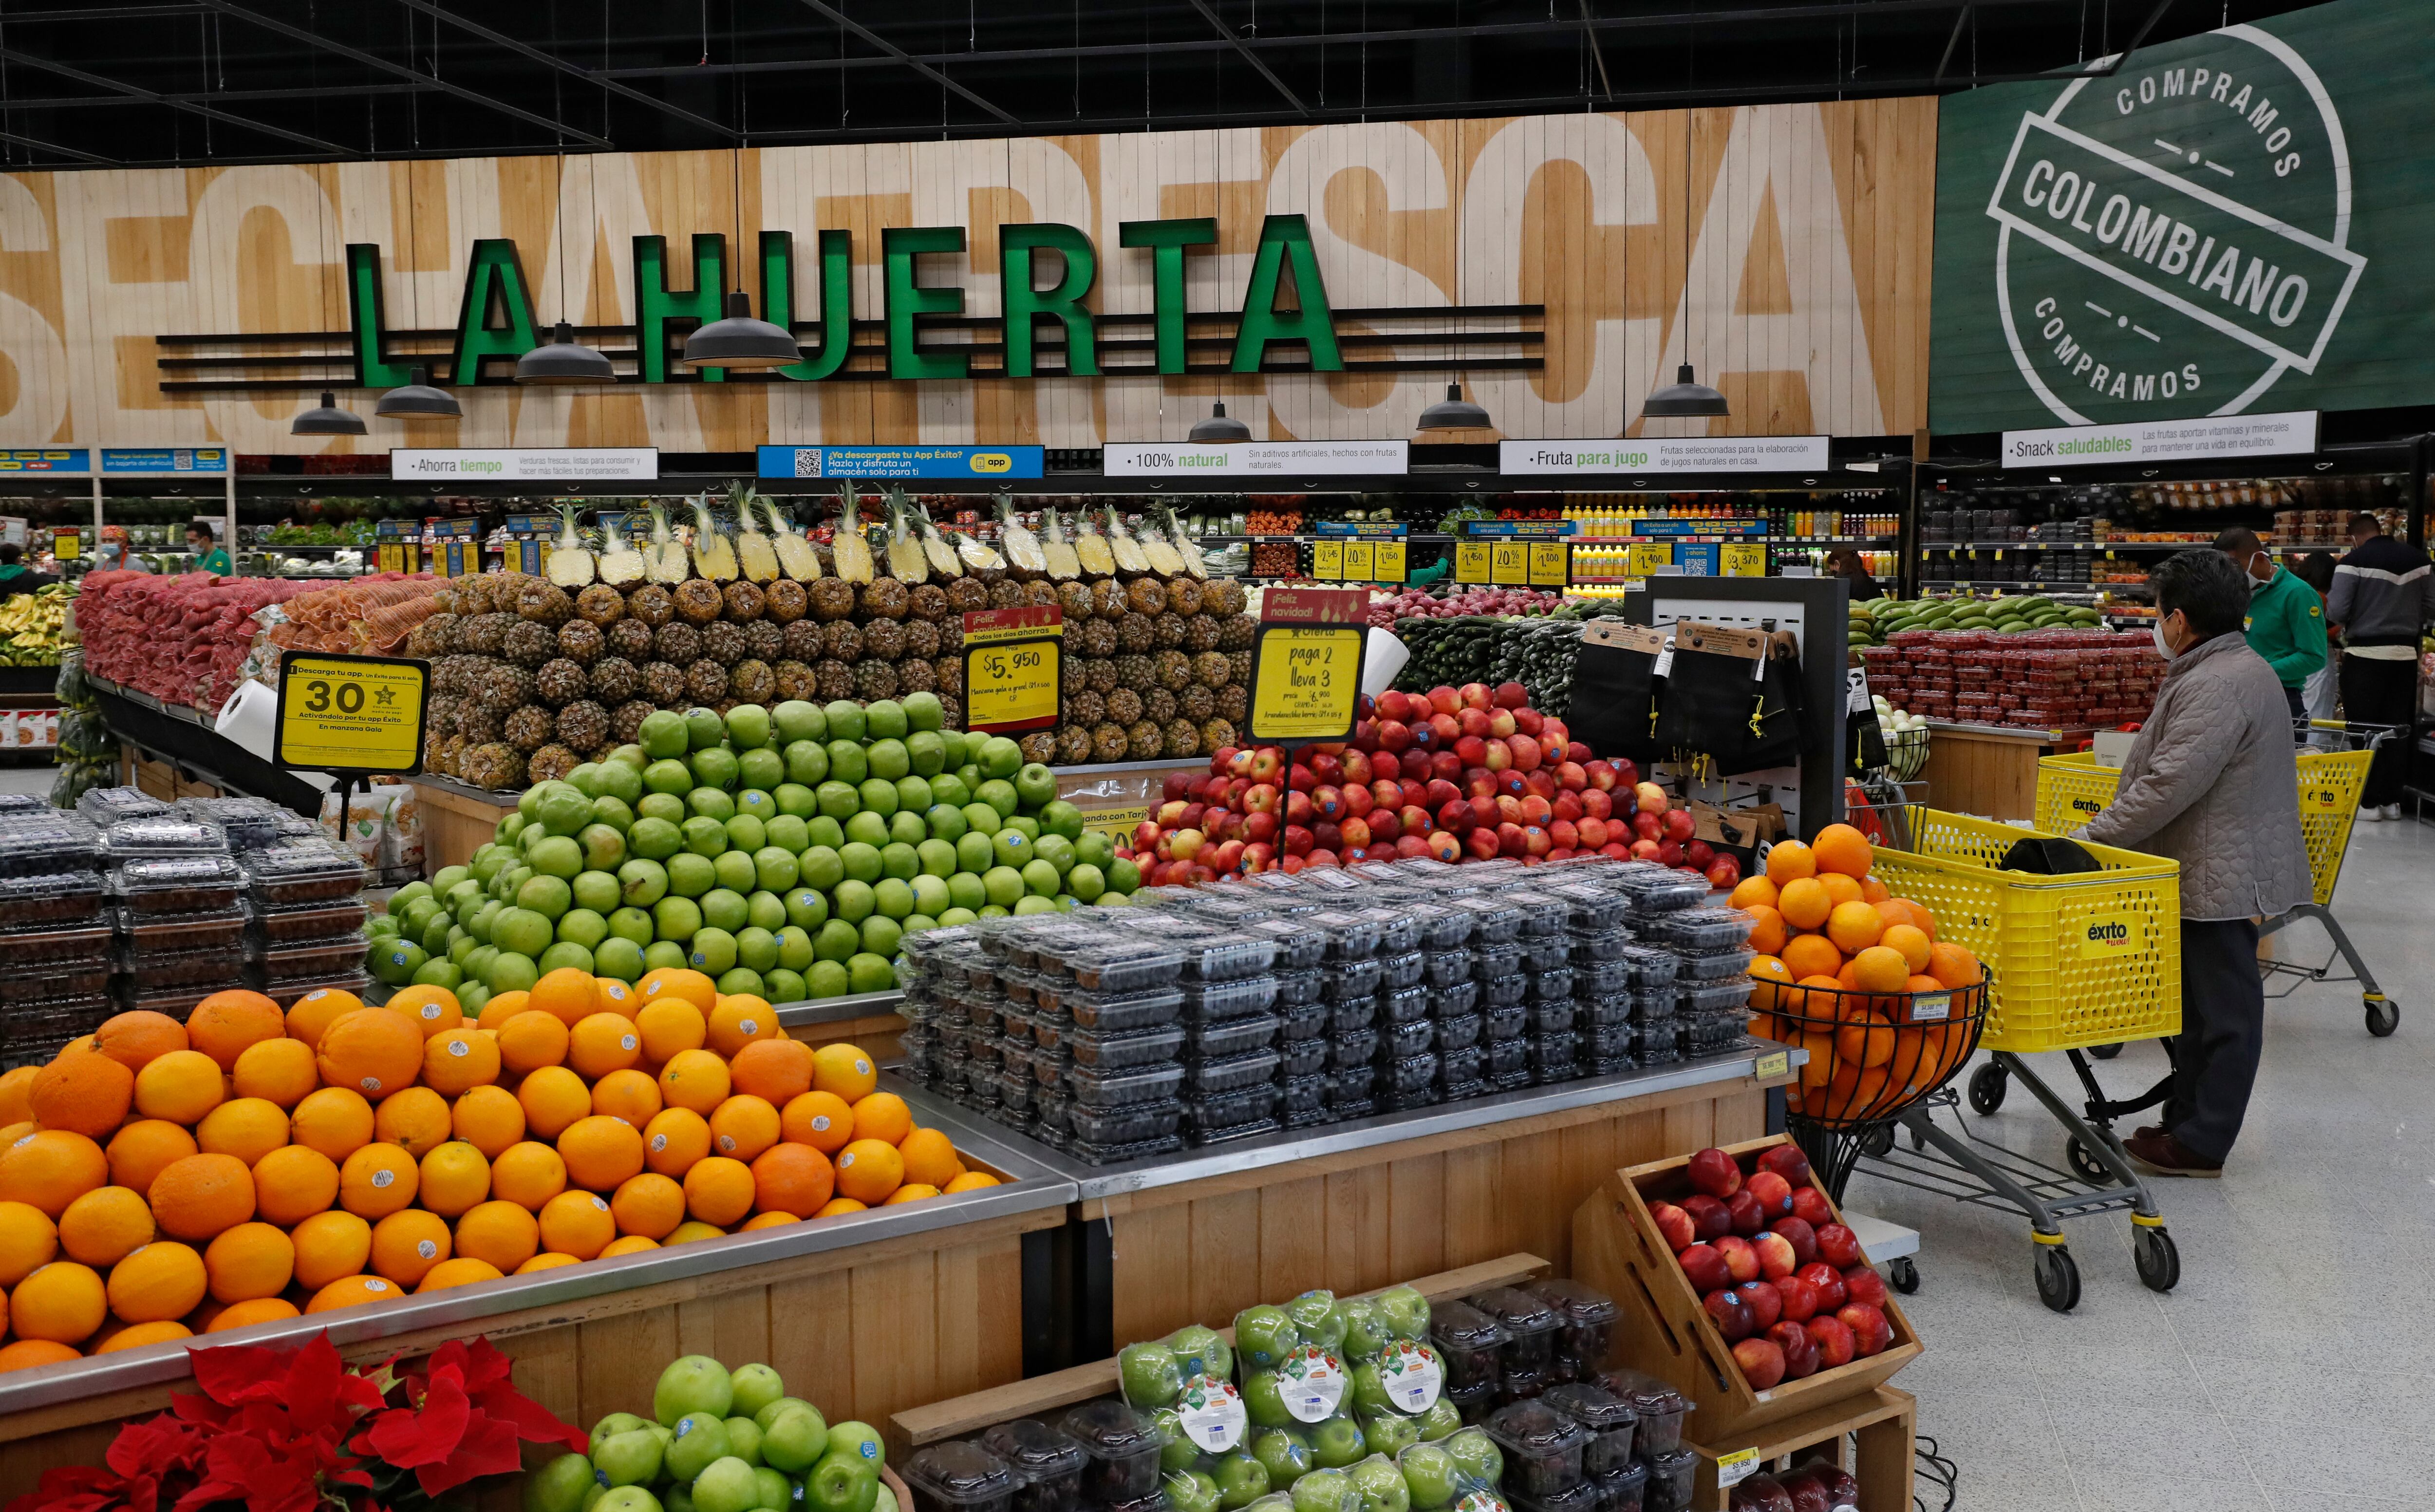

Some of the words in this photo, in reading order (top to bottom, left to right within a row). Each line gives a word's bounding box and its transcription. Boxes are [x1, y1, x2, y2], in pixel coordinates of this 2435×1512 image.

[2116, 68, 2301, 178] COMPRAMOS
[2022, 159, 2309, 328] COLOMBIANO
[346, 237, 544, 388] LA
[632, 213, 1346, 383] HUERTA
[2035, 296, 2201, 401] COMPRAMOS
[2143, 430, 2155, 440] Las
[2157, 429, 2177, 439] frutas
[2179, 428, 2207, 439] aportan
[2209, 425, 2244, 437] vitaminas
[2246, 427, 2250, 436] y
[2252, 422, 2289, 433] minerales
[1661, 446, 1683, 454] Frutas
[1686, 445, 1737, 454] seleccionadas
[1739, 447, 1755, 455] para
[1757, 445, 1764, 453] la
[1766, 444, 1808, 453] elaboración
[2017, 440, 2054, 457] Snack
[2058, 436, 2132, 456] saludables
[2143, 445, 2158, 455] para
[2160, 442, 2193, 452] mantener
[2195, 442, 2209, 450] una
[2211, 439, 2226, 449] vida
[2240, 438, 2276, 450] equilibrio.
[828, 452, 843, 460] ¿Ya
[845, 451, 901, 461] descargaste
[914, 451, 933, 461] App
[935, 449, 963, 459] Éxito?
[1262, 449, 1289, 458] aditivos
[1292, 448, 1330, 459] artificiales,
[1332, 448, 1358, 457] hechos
[1376, 448, 1397, 457] frutas
[1538, 451, 1573, 465] Fruta
[1577, 453, 1611, 468] para
[1614, 450, 1648, 467] jugo
[606, 456, 635, 465] consumir
[828, 459, 853, 467] Hazlo
[855, 461, 861, 469] y
[868, 459, 901, 468] disfruta
[988, 458, 1005, 467] app
[1136, 453, 1174, 467] 100%
[1179, 452, 1228, 467] natural
[1249, 461, 1284, 469] naturales.
[1661, 458, 1669, 466] de
[1671, 457, 1690, 467] jugos
[1693, 457, 1726, 466] naturales
[418, 459, 456, 472] Ahorra
[460, 459, 502, 475] tiempo
[553, 467, 573, 475] fáciles
[585, 467, 631, 477] preparaciones.
[828, 467, 866, 476] almacén
[868, 467, 887, 476] solo
[912, 467, 919, 476] ti
[1273, 594, 1297, 605] ¡Feliz
[1271, 607, 1313, 617] navidad!
[1017, 627, 1049, 636] ahorras
[1289, 648, 1320, 666] paga
[1325, 647, 1332, 664] 2
[299, 667, 336, 675] Descarga
[347, 669, 364, 677] app.
[1291, 666, 1316, 687] lleva
[1321, 670, 1330, 687] 3
[305, 680, 365, 714] 30
[299, 712, 343, 721] Activándolo
[383, 715, 401, 723] Éxito
[2073, 797, 2101, 813] éxito
[1083, 814, 1107, 823] ando
[2088, 921, 2126, 940] éxito
[2110, 936, 2130, 946] wow!
